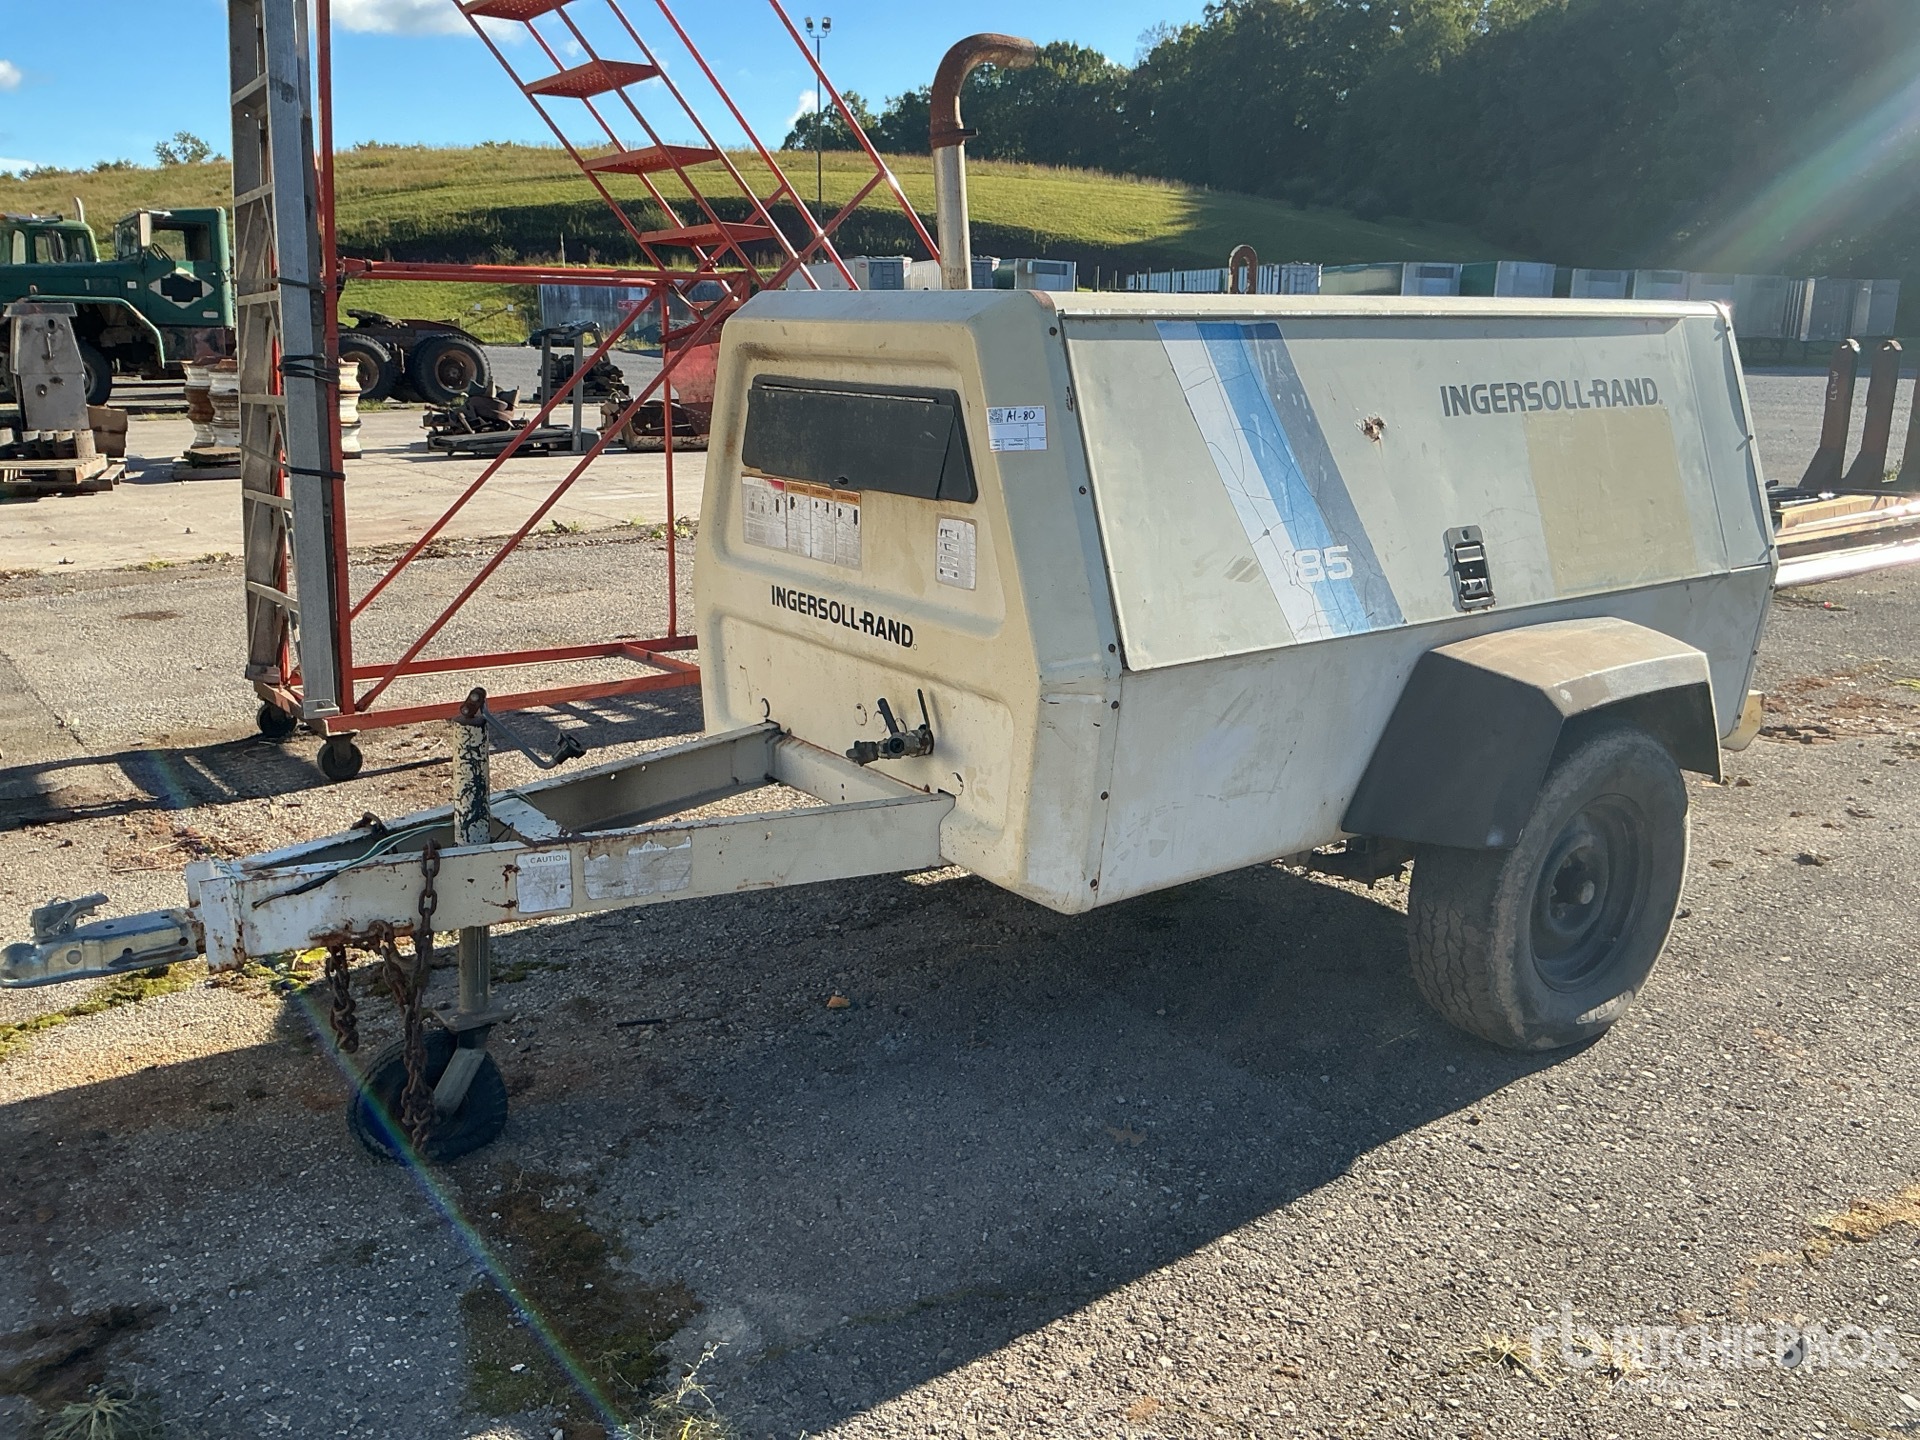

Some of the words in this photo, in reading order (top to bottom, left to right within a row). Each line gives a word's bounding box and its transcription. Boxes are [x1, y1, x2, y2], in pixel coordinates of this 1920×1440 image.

[1440, 377, 1659, 416] INGERSOLL-RAND
[771, 585, 914, 648] INGERSOLL-RAND
[530, 854, 567, 864] CAUTION
